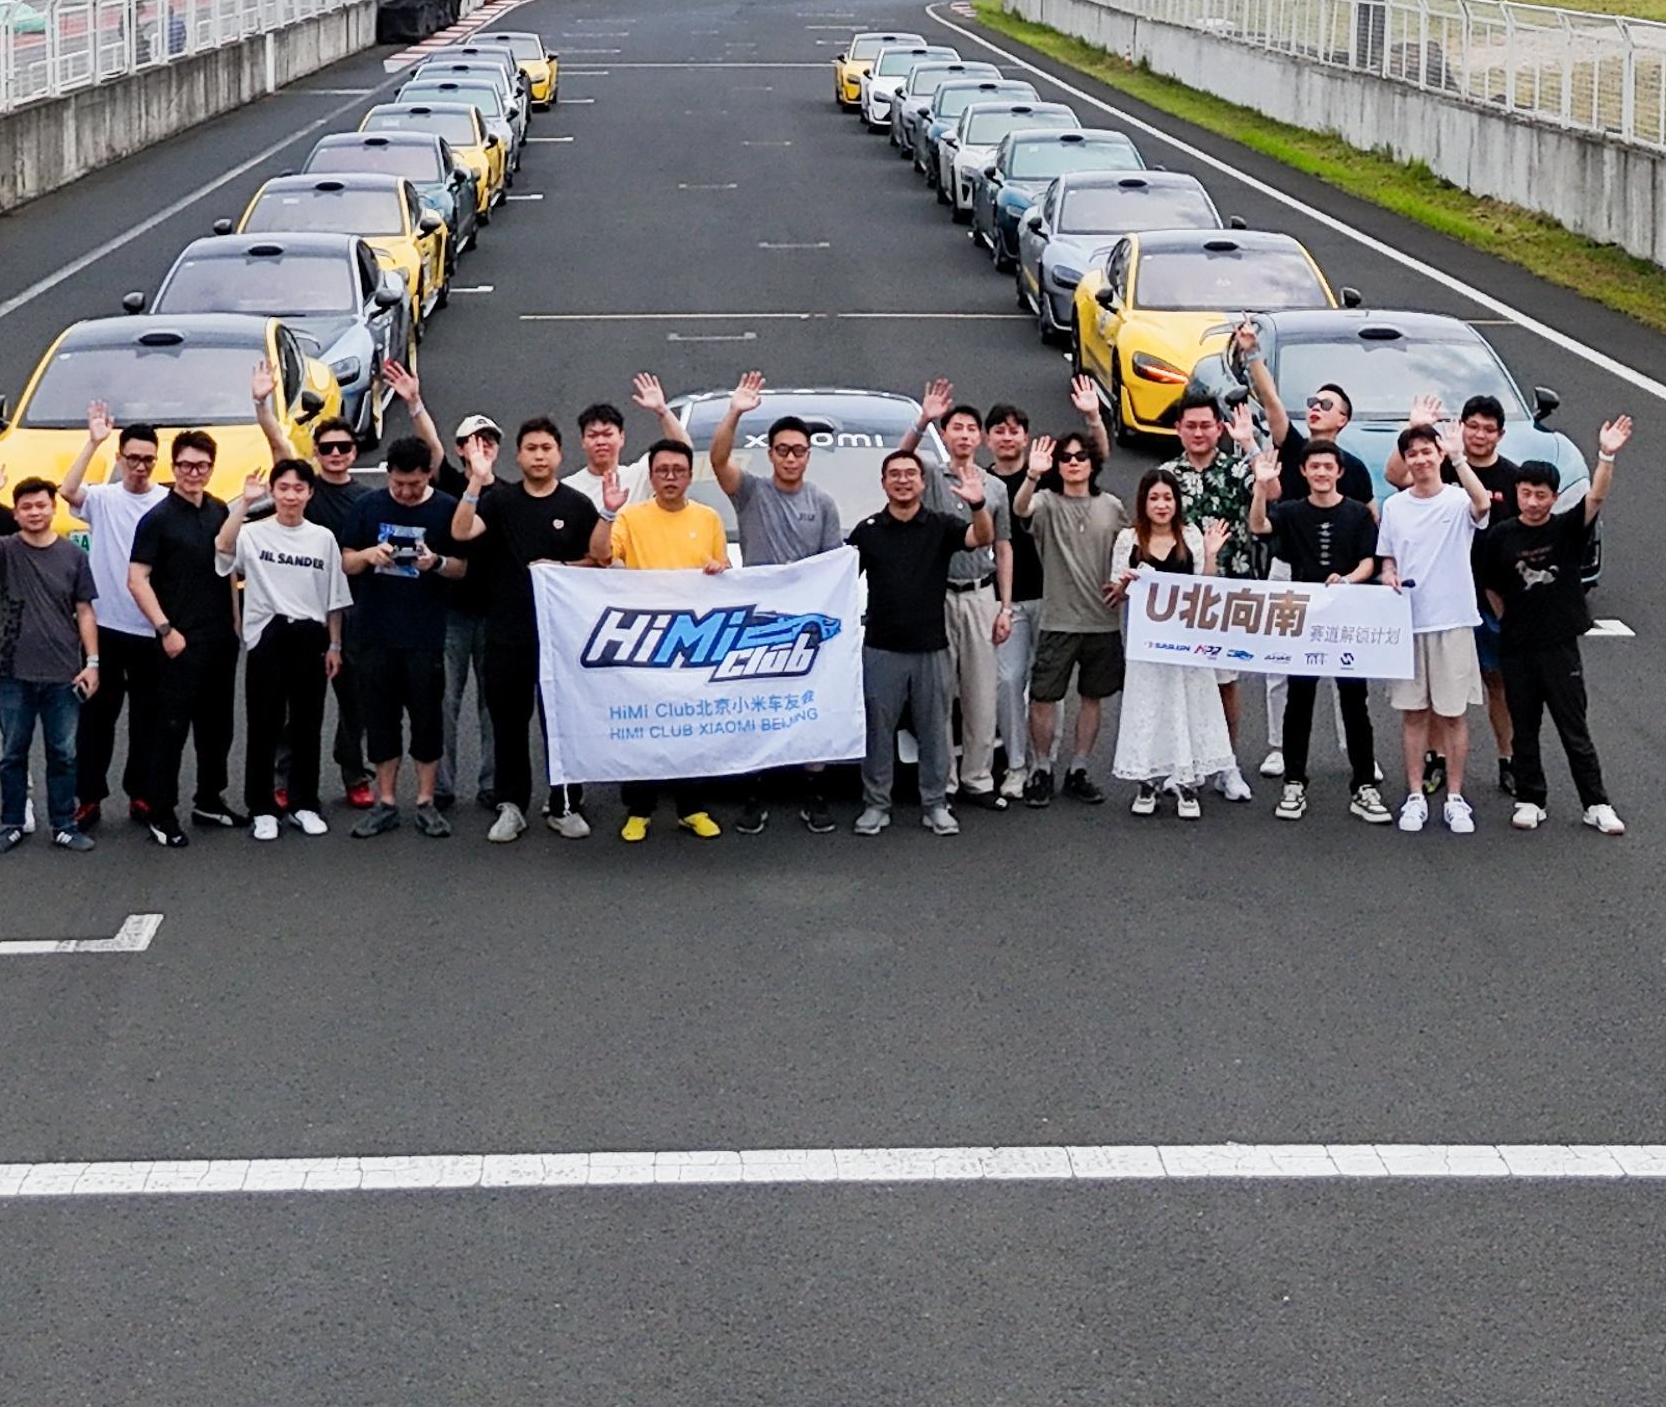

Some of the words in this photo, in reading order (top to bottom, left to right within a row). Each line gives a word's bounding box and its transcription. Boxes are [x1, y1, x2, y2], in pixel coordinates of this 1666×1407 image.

[744, 432, 884, 448] xomi
[259, 550, 275, 563] JIL
[277, 553, 325, 570] SANDER
[1145, 582, 1311, 638] U北向南
[584, 607, 749, 665] HiMi
[609, 704, 648, 720] HiMi
[610, 726, 644, 740] HIMI
[649, 724, 693, 739] CLUB
[699, 719, 755, 736] XIAOMI
